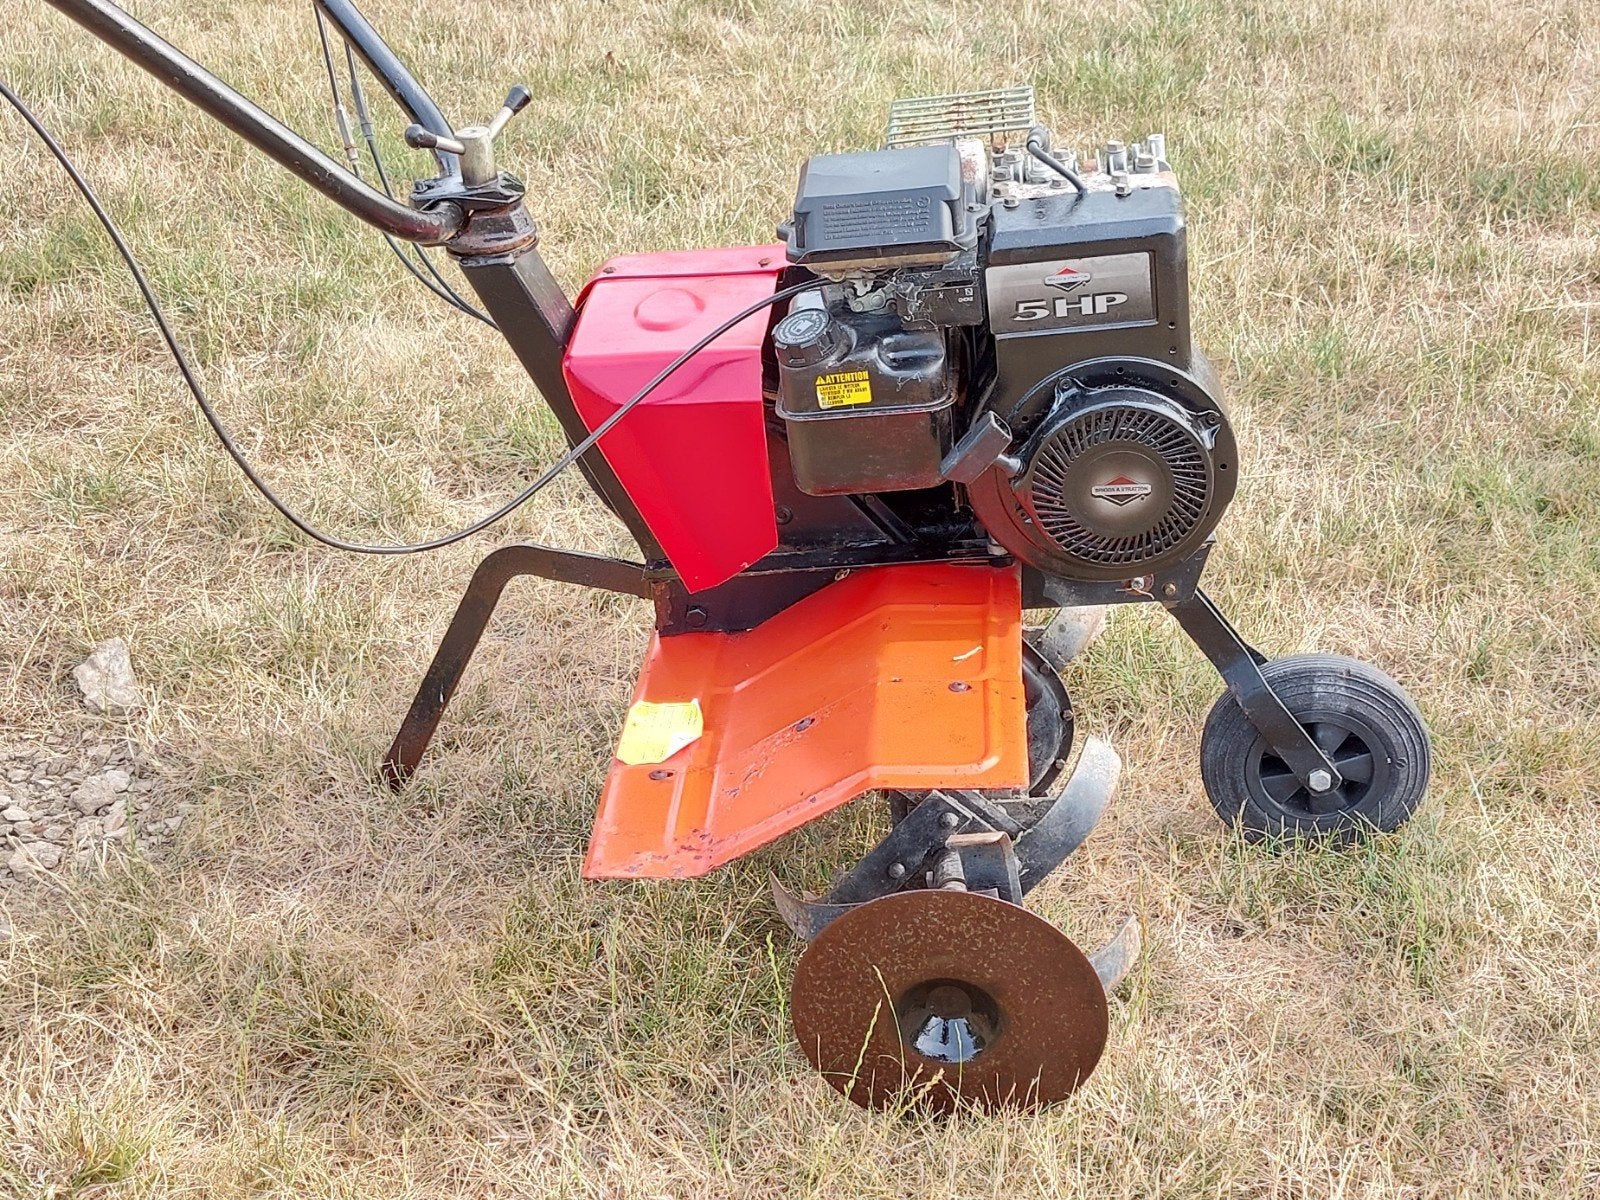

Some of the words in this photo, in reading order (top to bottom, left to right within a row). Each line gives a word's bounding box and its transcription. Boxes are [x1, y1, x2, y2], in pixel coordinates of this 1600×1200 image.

[1012, 299, 1050, 321] 5
[1053, 291, 1128, 318] HP
[825, 370, 869, 384] ATTENTION
